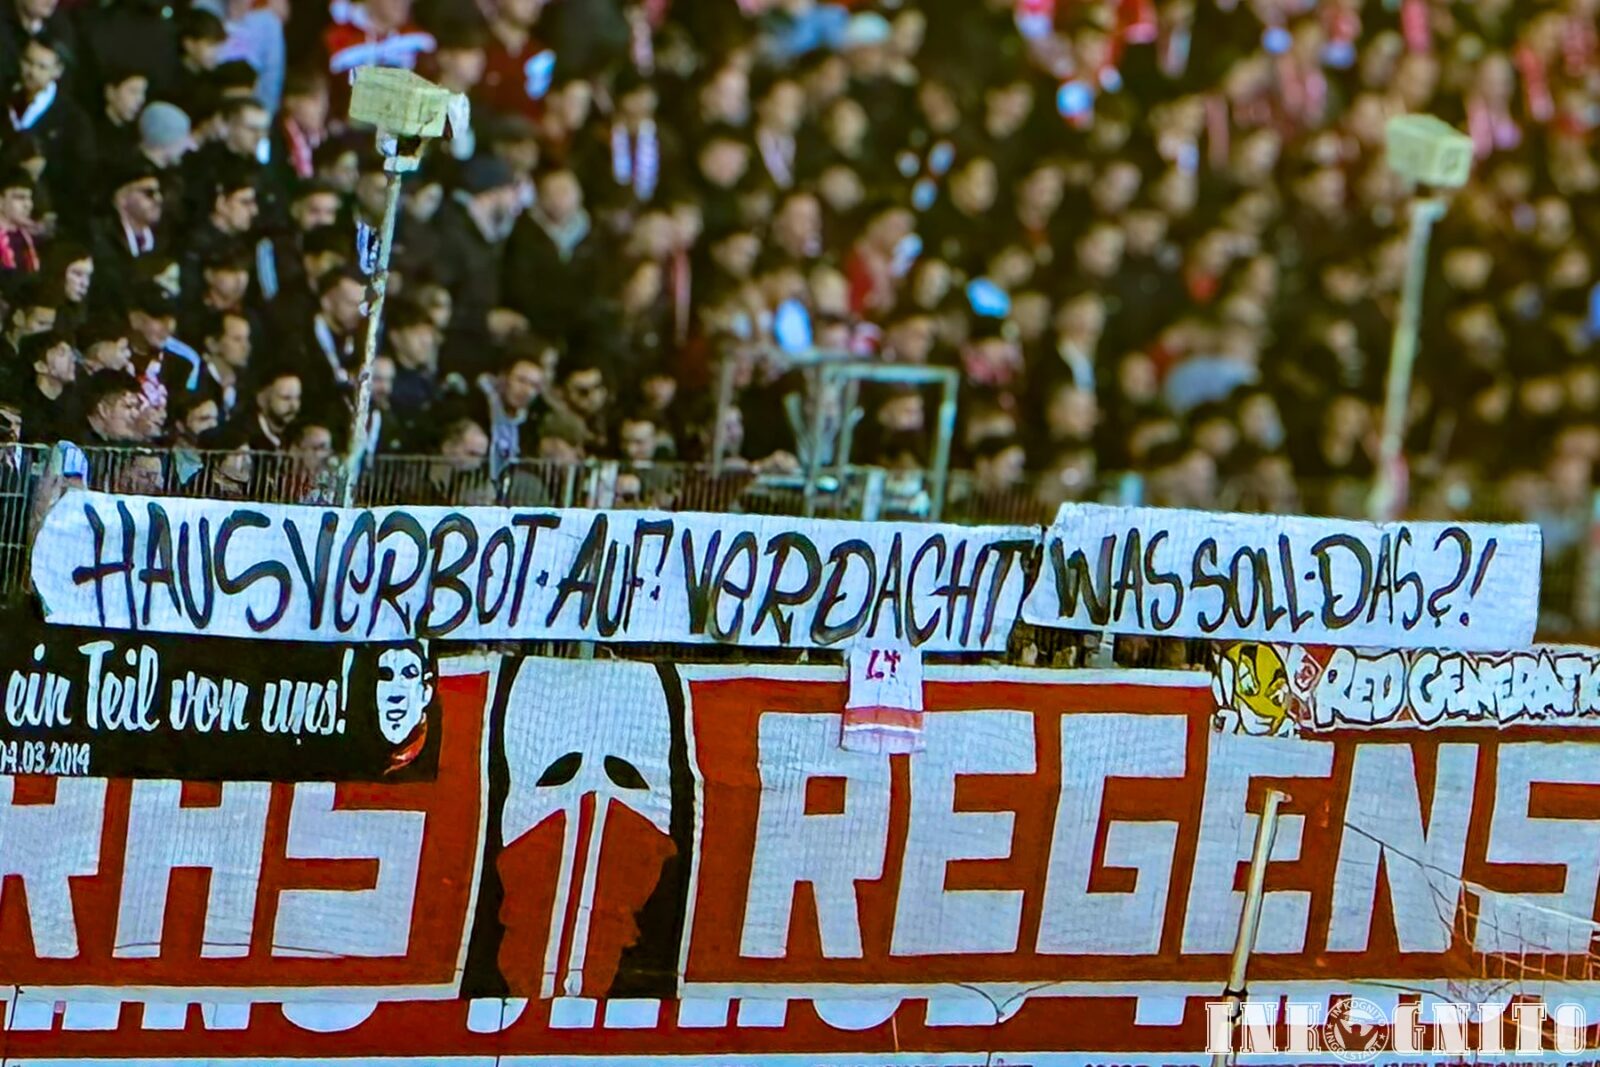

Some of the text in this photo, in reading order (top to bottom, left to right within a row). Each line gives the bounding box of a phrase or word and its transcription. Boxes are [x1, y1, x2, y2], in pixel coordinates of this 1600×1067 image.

[1050, 527, 1183, 632] WAS
[5, 643, 73, 729] ein
[77, 640, 161, 732] Teil
[168, 675, 250, 733] von
[1312, 645, 1407, 730] RED
